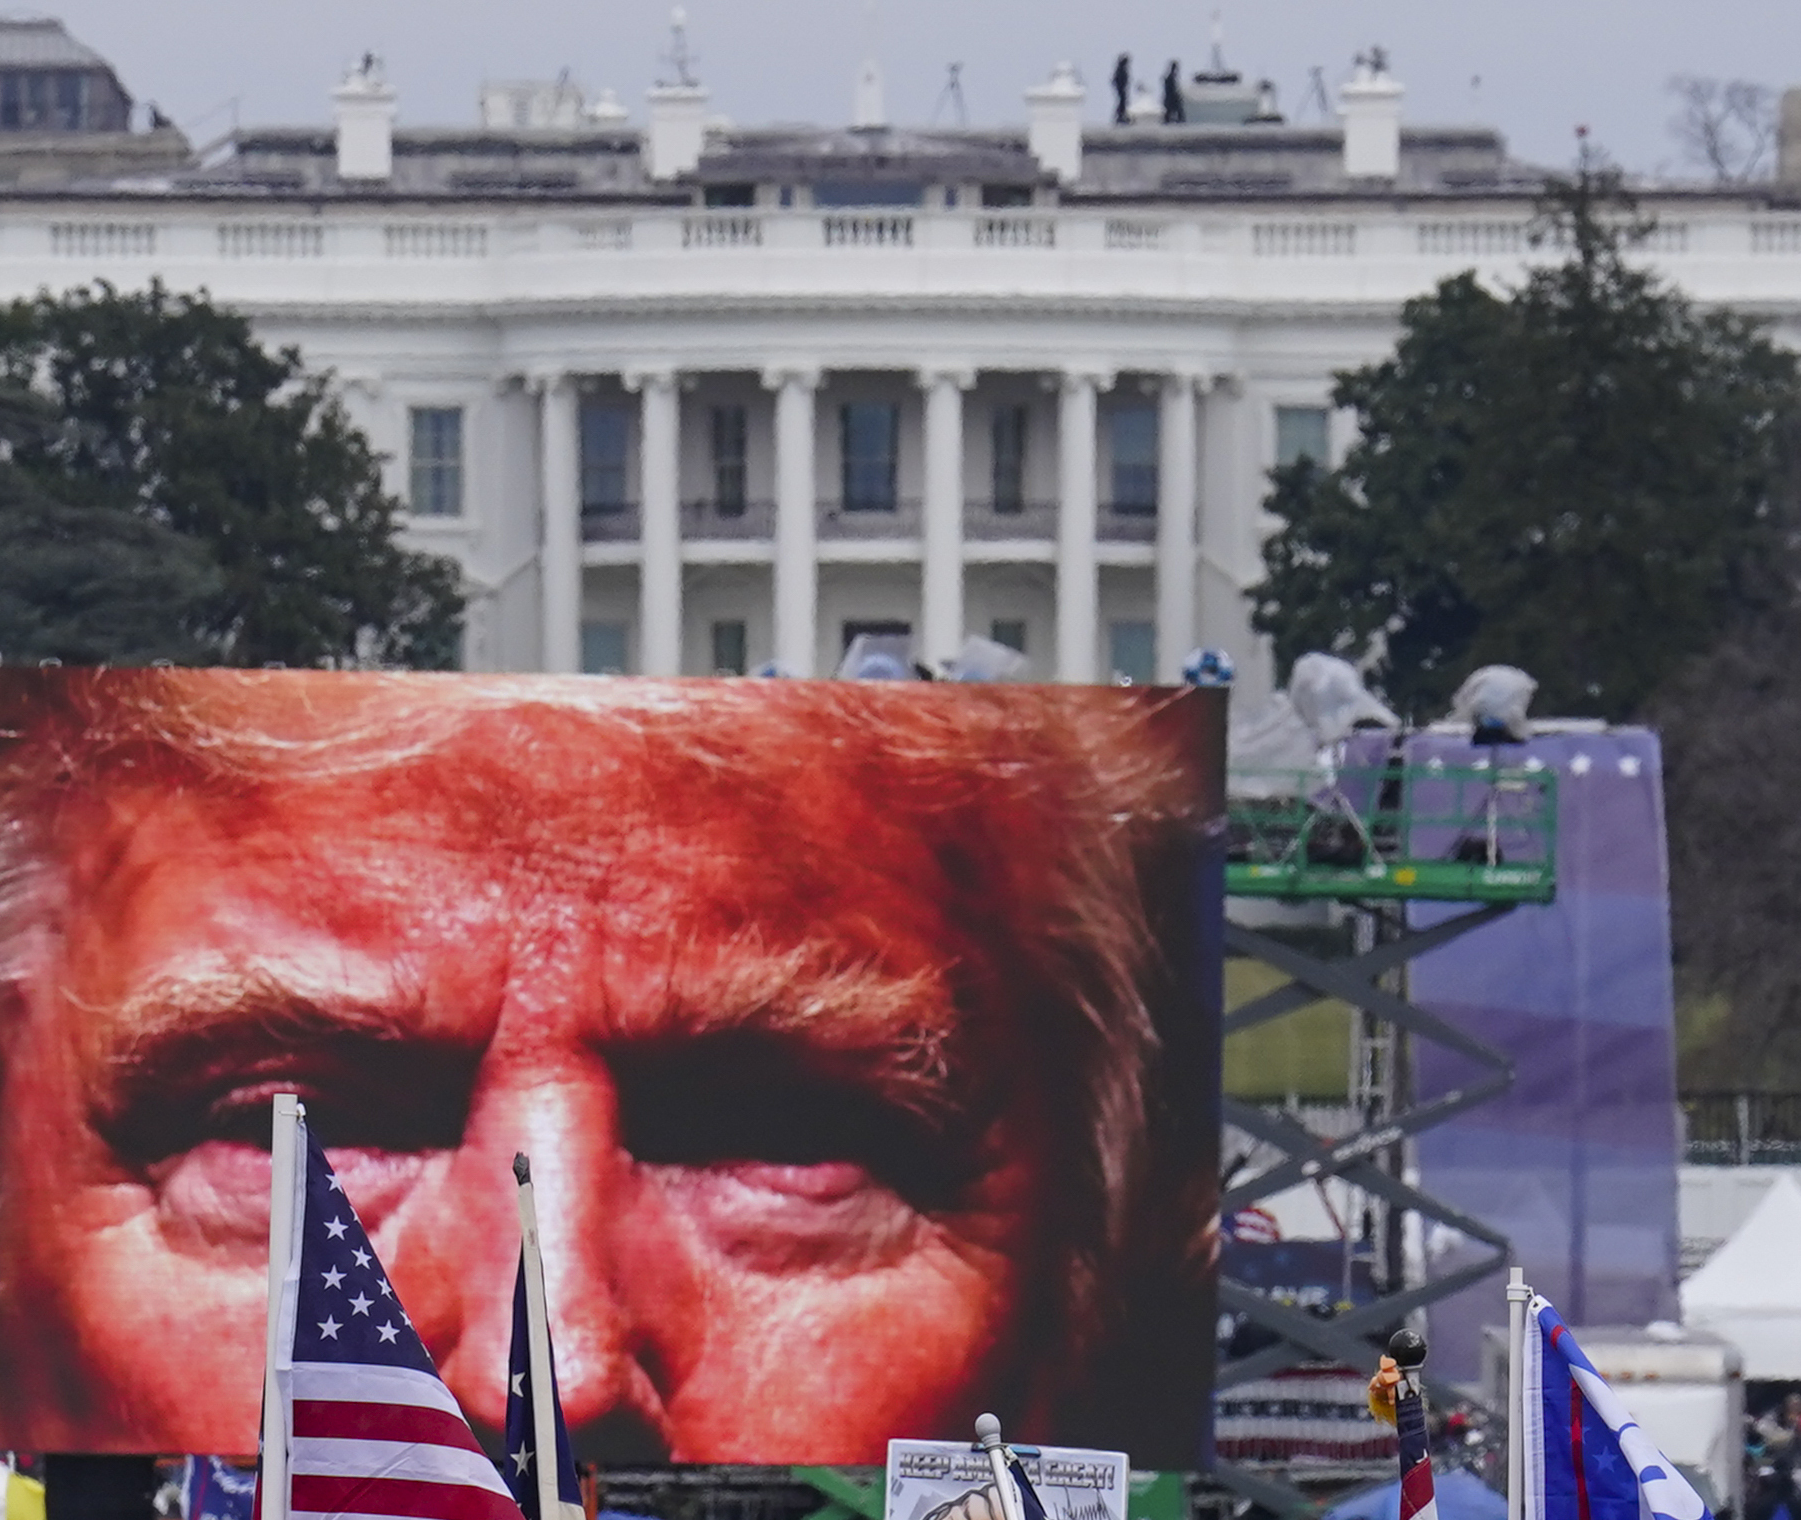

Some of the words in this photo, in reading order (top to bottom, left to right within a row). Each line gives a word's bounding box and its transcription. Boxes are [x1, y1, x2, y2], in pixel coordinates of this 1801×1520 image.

[899, 1453, 951, 1480] KEEP
[952, 1455, 1041, 1486] AMEA
[1046, 1460, 1116, 1490] GREAT!
